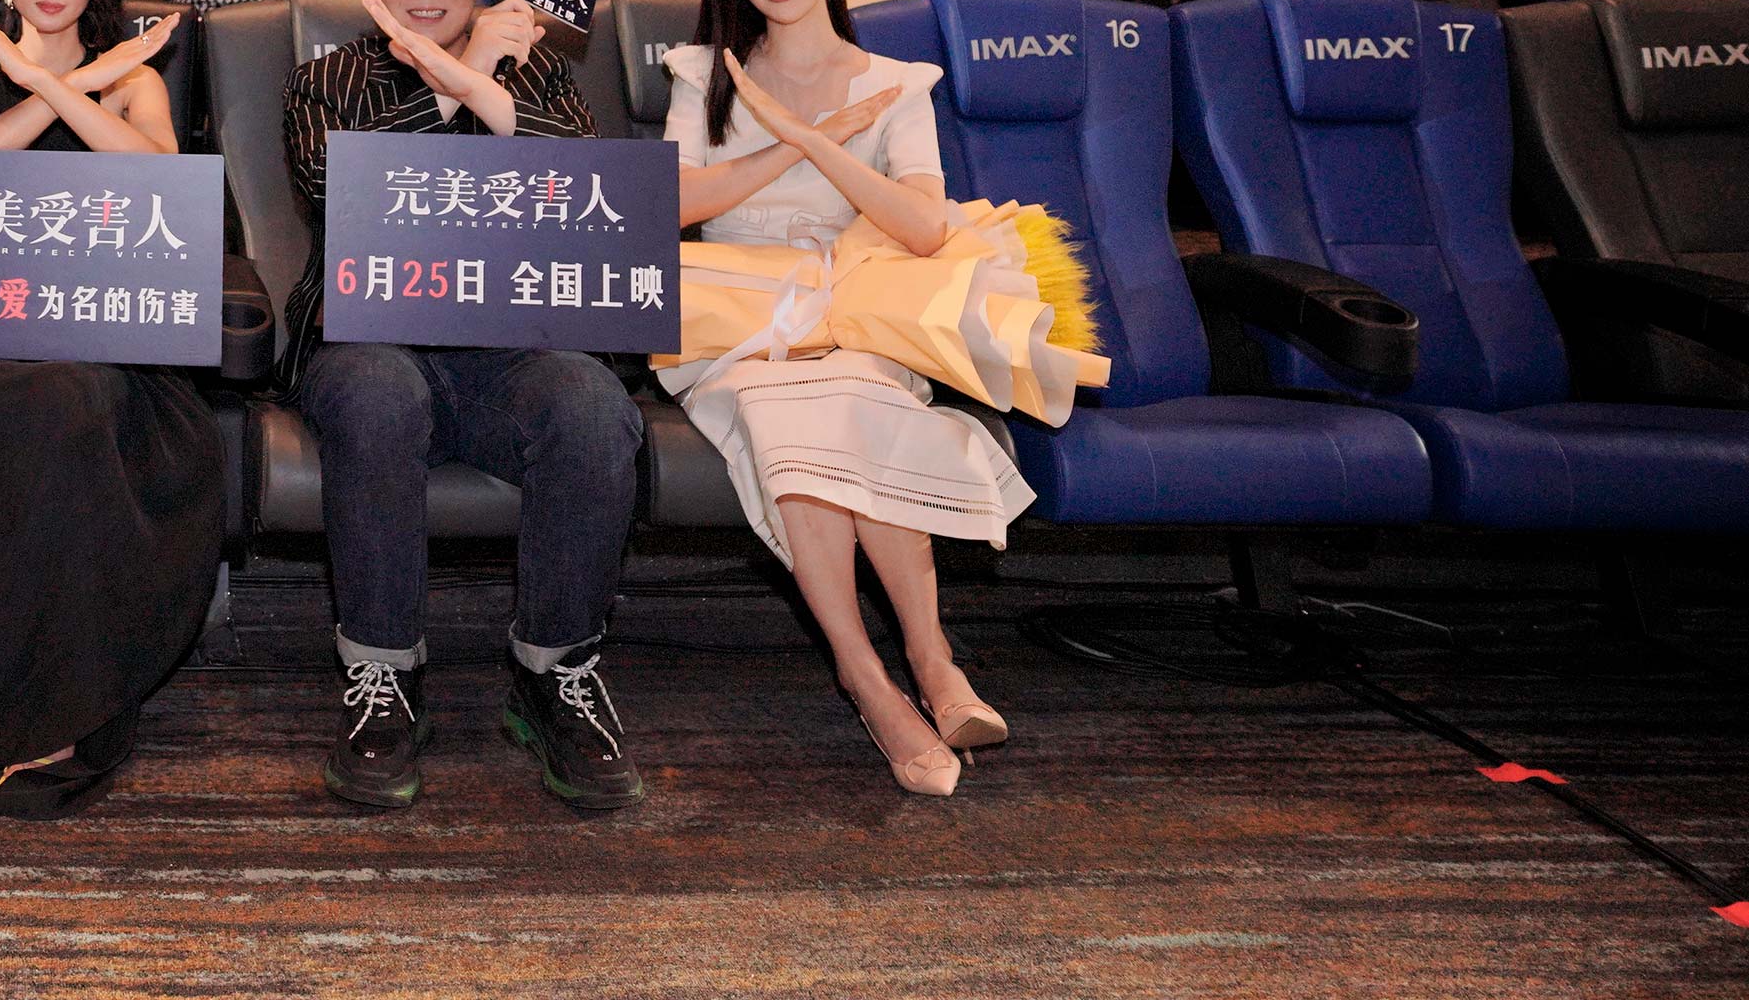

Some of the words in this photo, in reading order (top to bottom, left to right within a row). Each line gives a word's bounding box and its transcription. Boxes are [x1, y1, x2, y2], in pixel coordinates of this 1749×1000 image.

[970, 33, 1076, 60] IMAX
[1105, 18, 1141, 49] 16
[1438, 22, 1476, 53] 17
[1304, 36, 1413, 61] IMAX
[1641, 43, 1749, 69] IMAX
[384, 165, 625, 224] 完美受害人
[383, 217, 420, 226] THE
[441, 219, 540, 231] PREFECT
[336, 255, 485, 305] 6月25日
[509, 260, 665, 311] 全国上映
